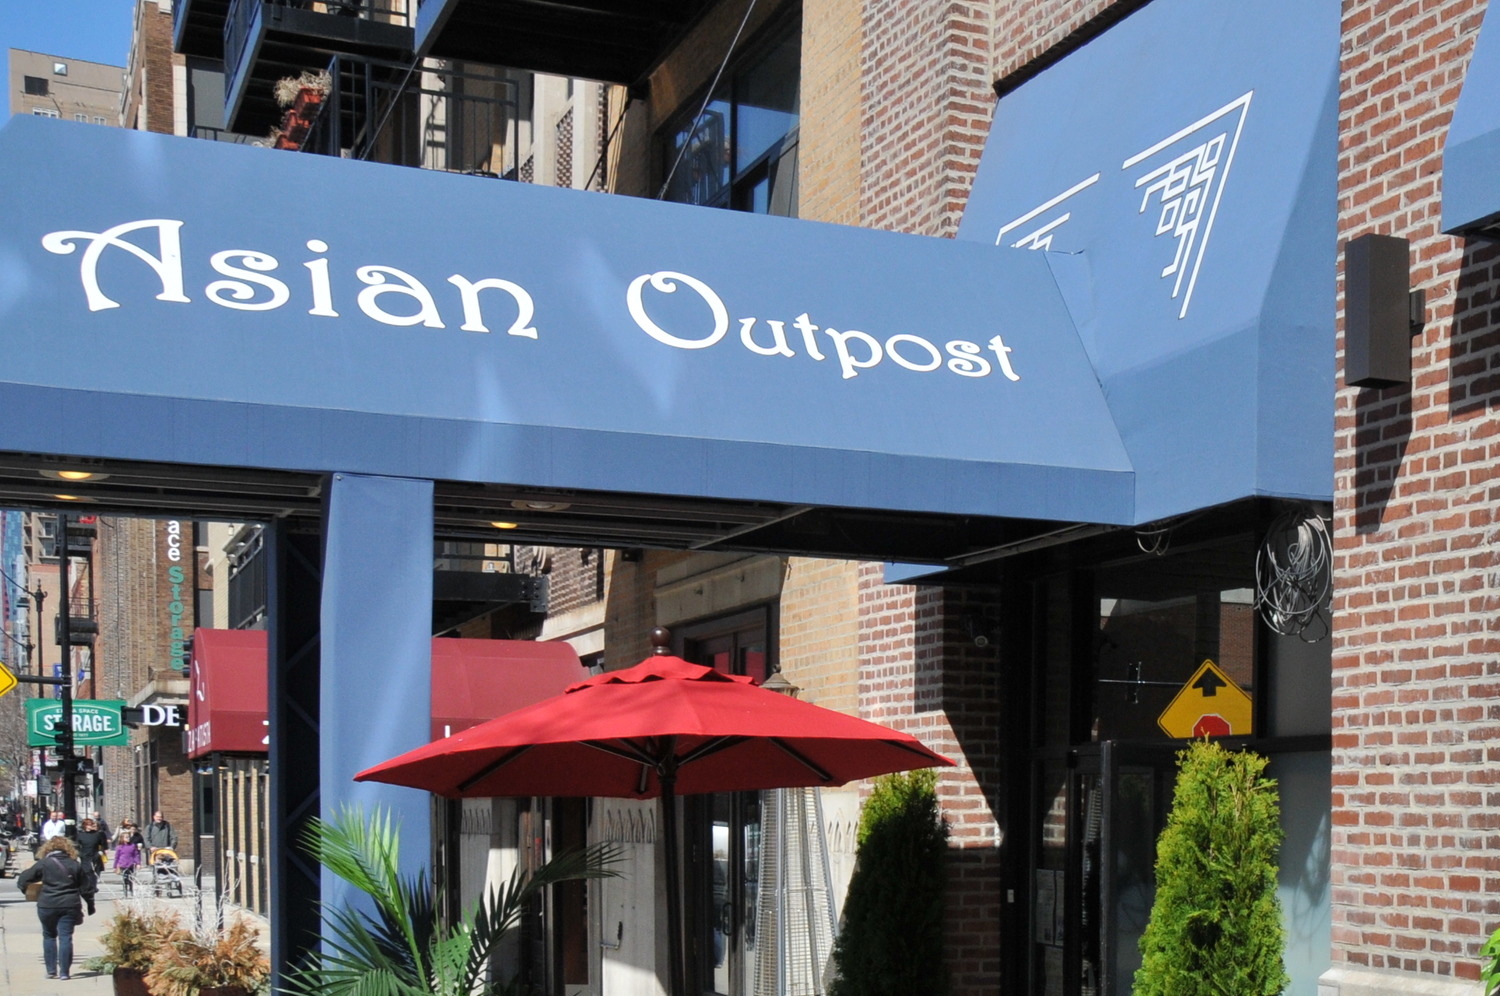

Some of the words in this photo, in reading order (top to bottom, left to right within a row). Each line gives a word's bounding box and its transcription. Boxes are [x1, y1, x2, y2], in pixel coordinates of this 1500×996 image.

[42, 219, 538, 340] Asian
[626, 271, 1021, 382] Outpost
[168, 566, 185, 671] Storage
[44, 714, 113, 732] STRAGE
